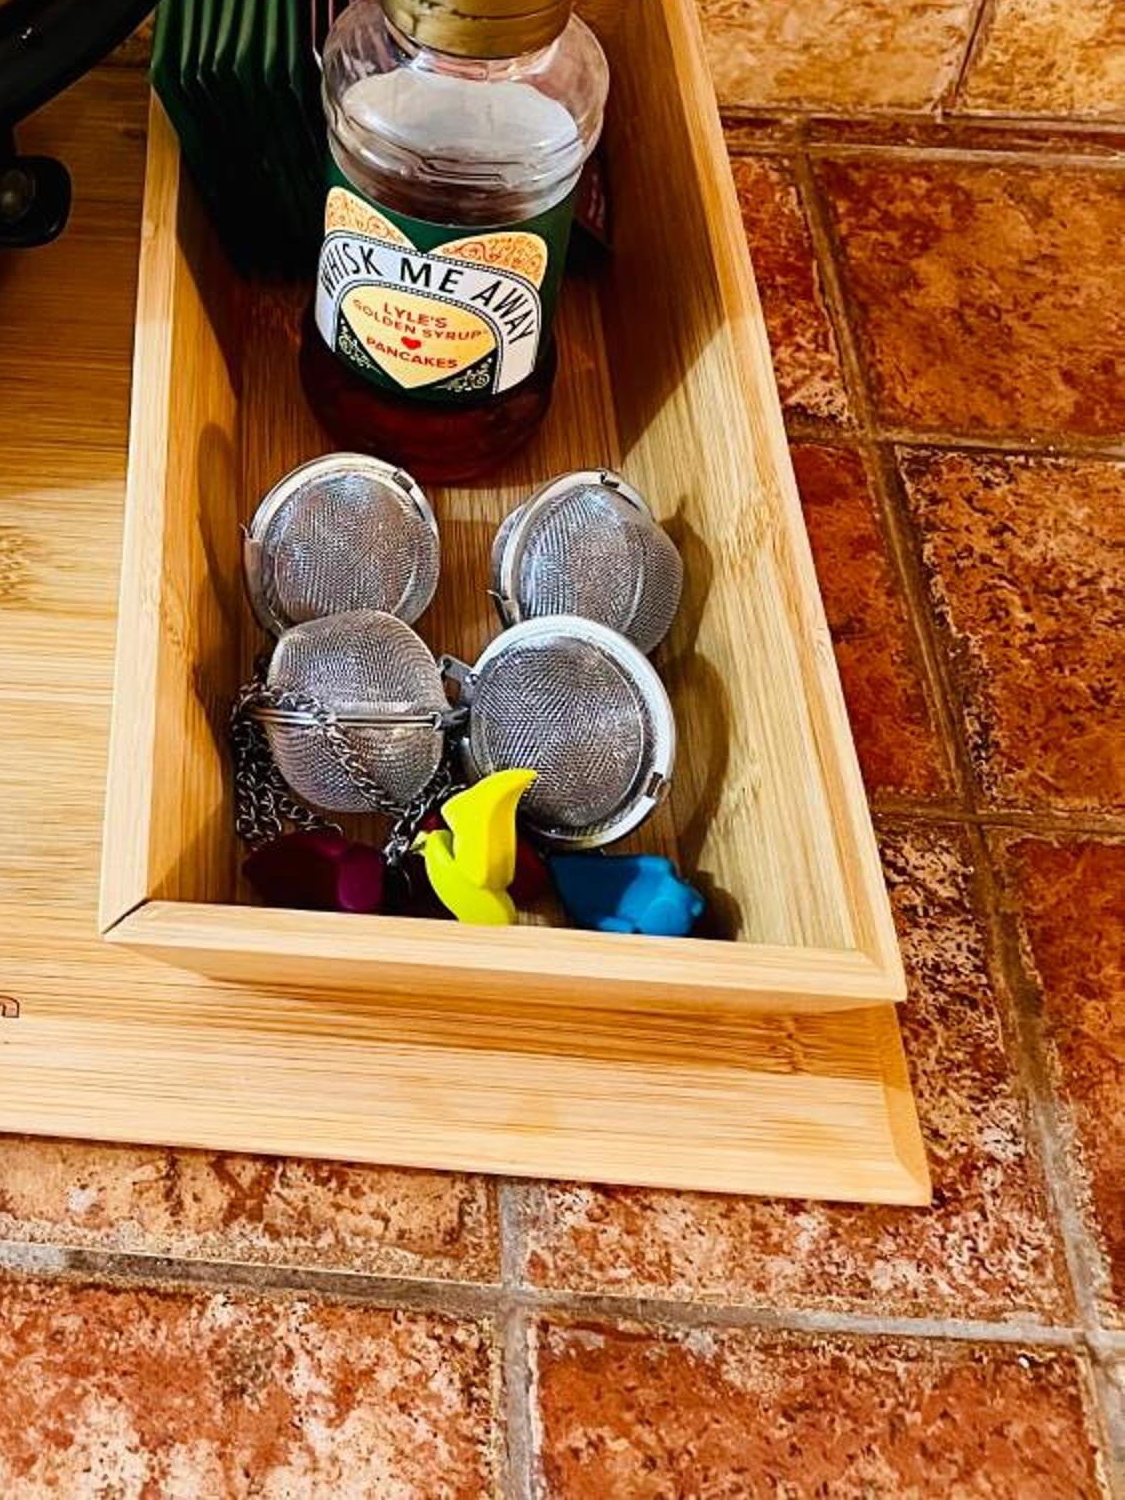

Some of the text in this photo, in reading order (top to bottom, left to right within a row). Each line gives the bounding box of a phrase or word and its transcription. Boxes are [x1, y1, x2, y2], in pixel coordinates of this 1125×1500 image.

[321, 242, 536, 345] WHISK ME AWAY
[352, 299, 417, 335] GOLDEN
[382, 301, 448, 329] LYLE'S
[365, 335, 459, 369] PANCAKES
